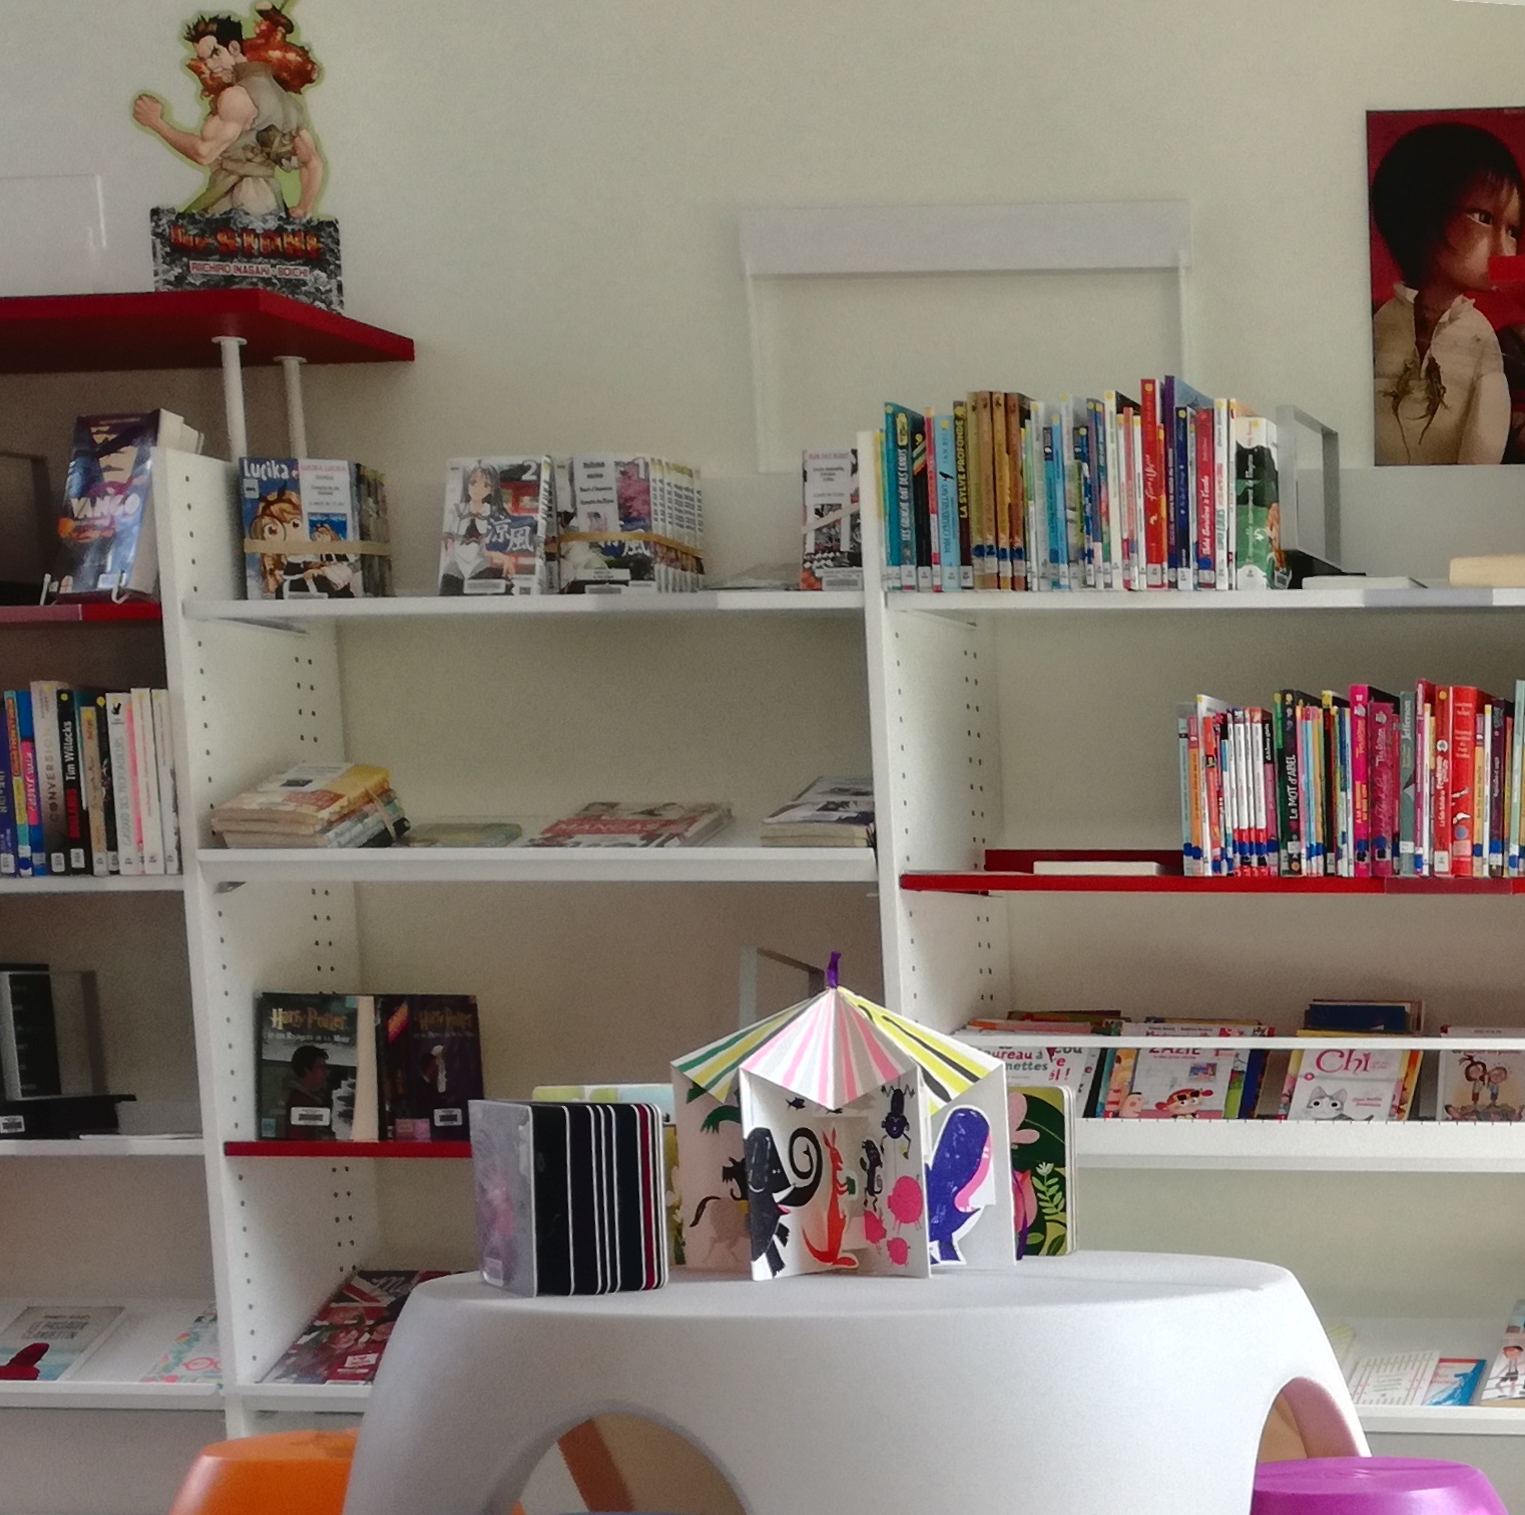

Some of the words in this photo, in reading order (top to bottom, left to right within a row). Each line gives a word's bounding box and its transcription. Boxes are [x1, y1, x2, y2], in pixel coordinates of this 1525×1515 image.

[955, 420, 966, 472] PROFONDE
[522, 460, 538, 481] 2
[957, 473, 967, 503] SYLVE
[959, 506, 968, 519] LA
[1401, 700, 1412, 740] Jefferson
[62, 720, 76, 762] Willocks
[65, 763, 77, 781] Tim
[1285, 754, 1297, 784] d'ABEL
[1287, 785, 1298, 806] MOT
[1289, 808, 1298, 819] Le
[270, 1007, 306, 1030] Harry
[307, 1007, 348, 1032] Potter
[1006, 1061, 1048, 1071] nettes
[1315, 1048, 1371, 1075] Chi
